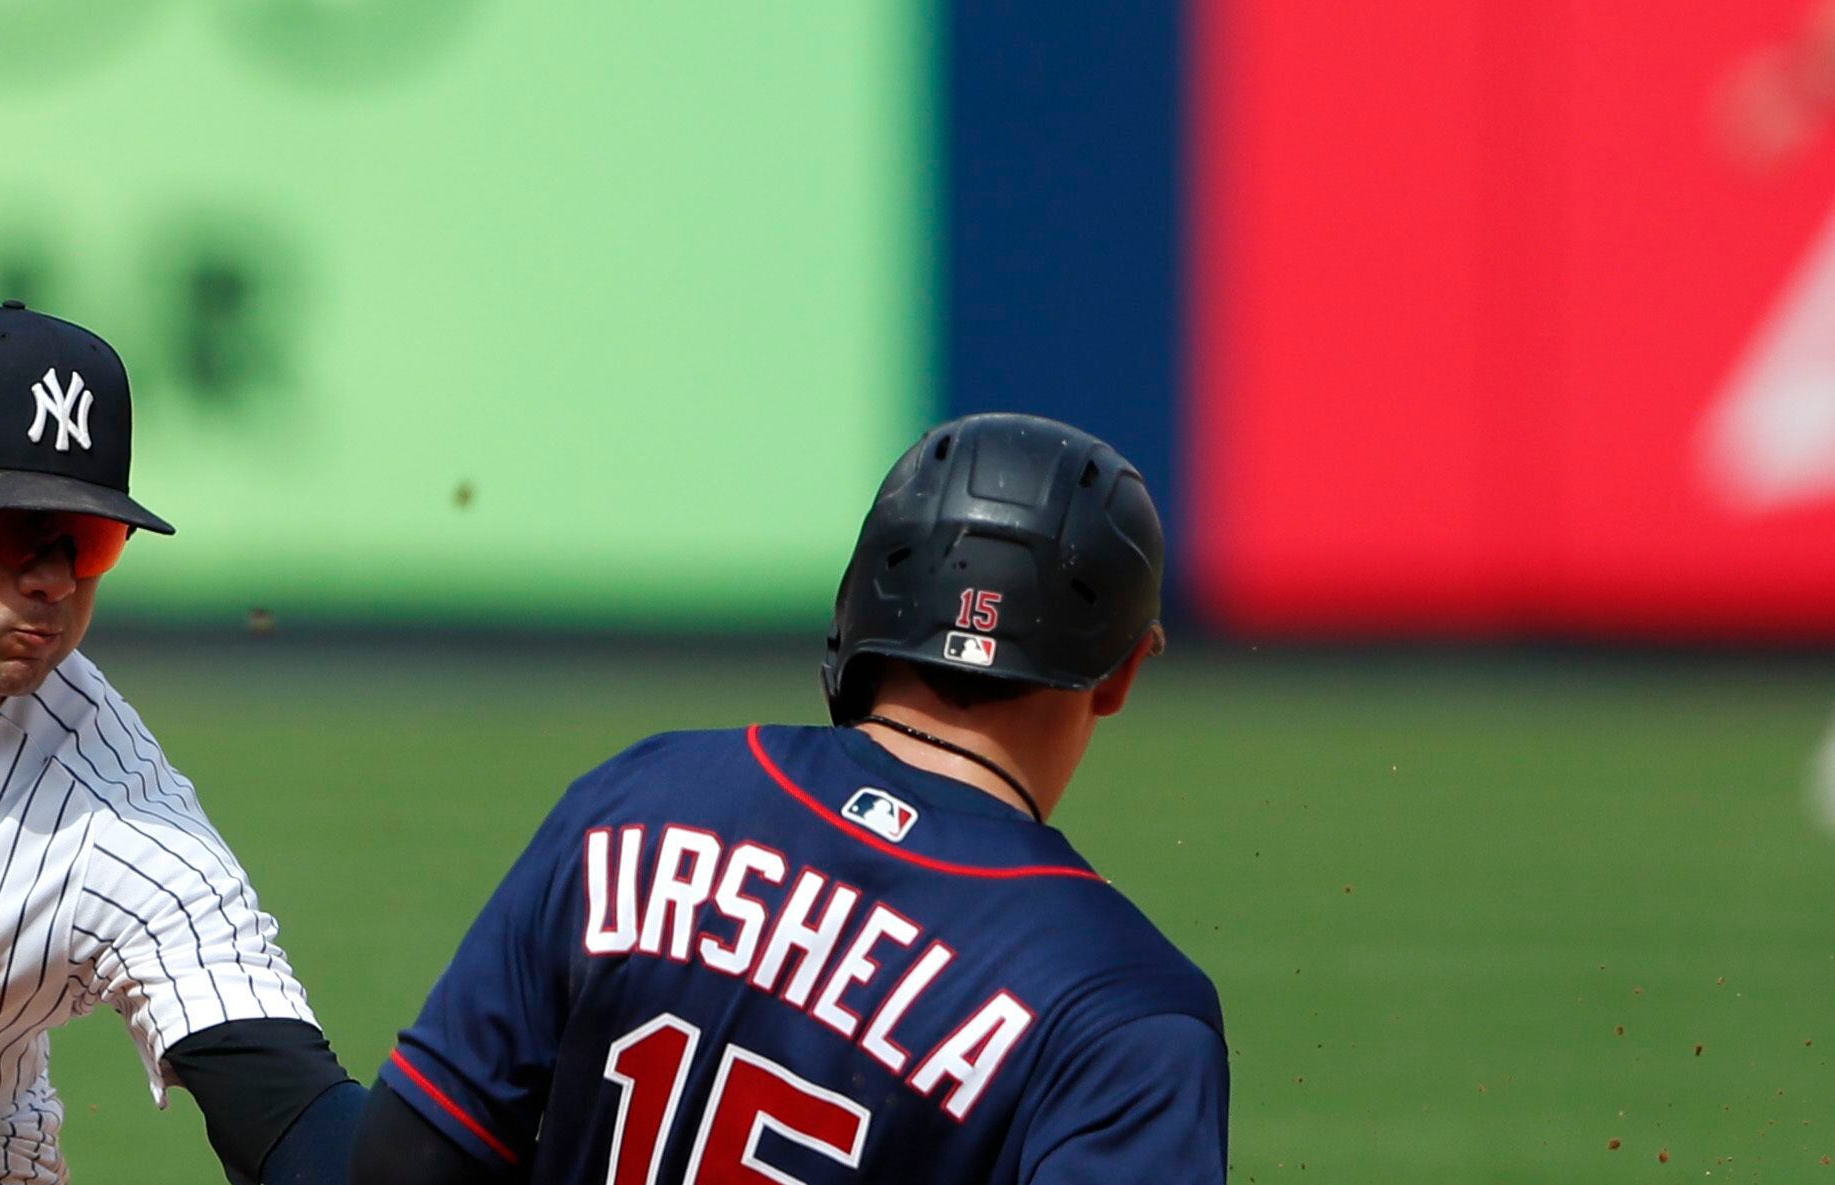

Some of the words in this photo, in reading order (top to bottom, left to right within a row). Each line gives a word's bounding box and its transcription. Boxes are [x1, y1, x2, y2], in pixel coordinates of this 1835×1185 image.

[28, 367, 94, 451] NY
[955, 588, 1002, 632] 15
[583, 824, 1037, 1124] URSHELA
